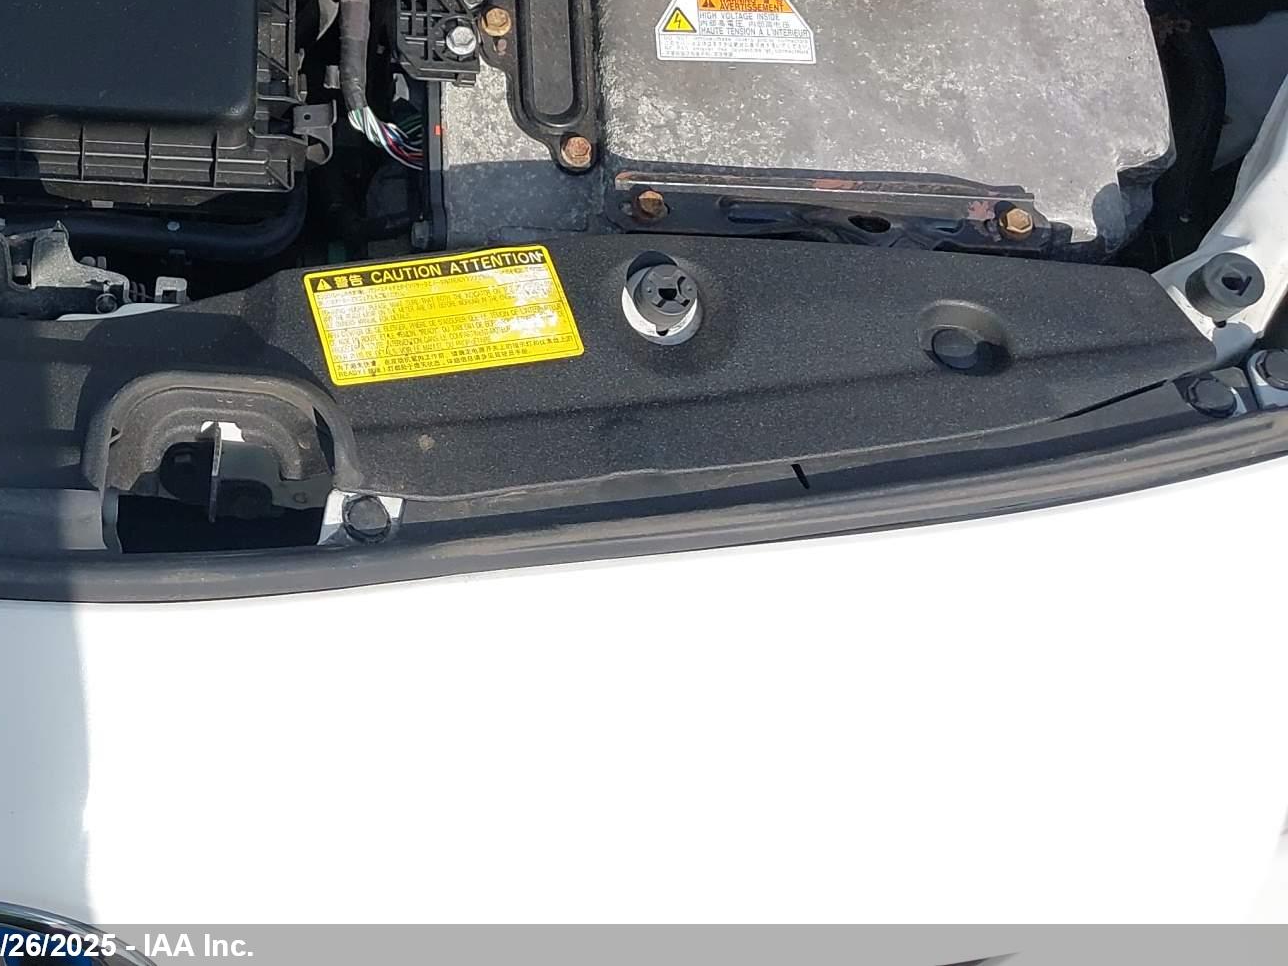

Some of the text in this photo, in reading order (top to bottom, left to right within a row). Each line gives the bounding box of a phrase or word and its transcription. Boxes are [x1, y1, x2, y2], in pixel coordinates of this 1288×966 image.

[719, 3, 785, 13] AVERTISSEMENT
[699, 12, 717, 20] HIGH
[757, 13, 780, 21] INSIDE
[701, 27, 724, 35] HAUTE
[727, 27, 756, 36] TENSION
[370, 264, 441, 284] CAUTION
[450, 251, 541, 275] ATTENTION
